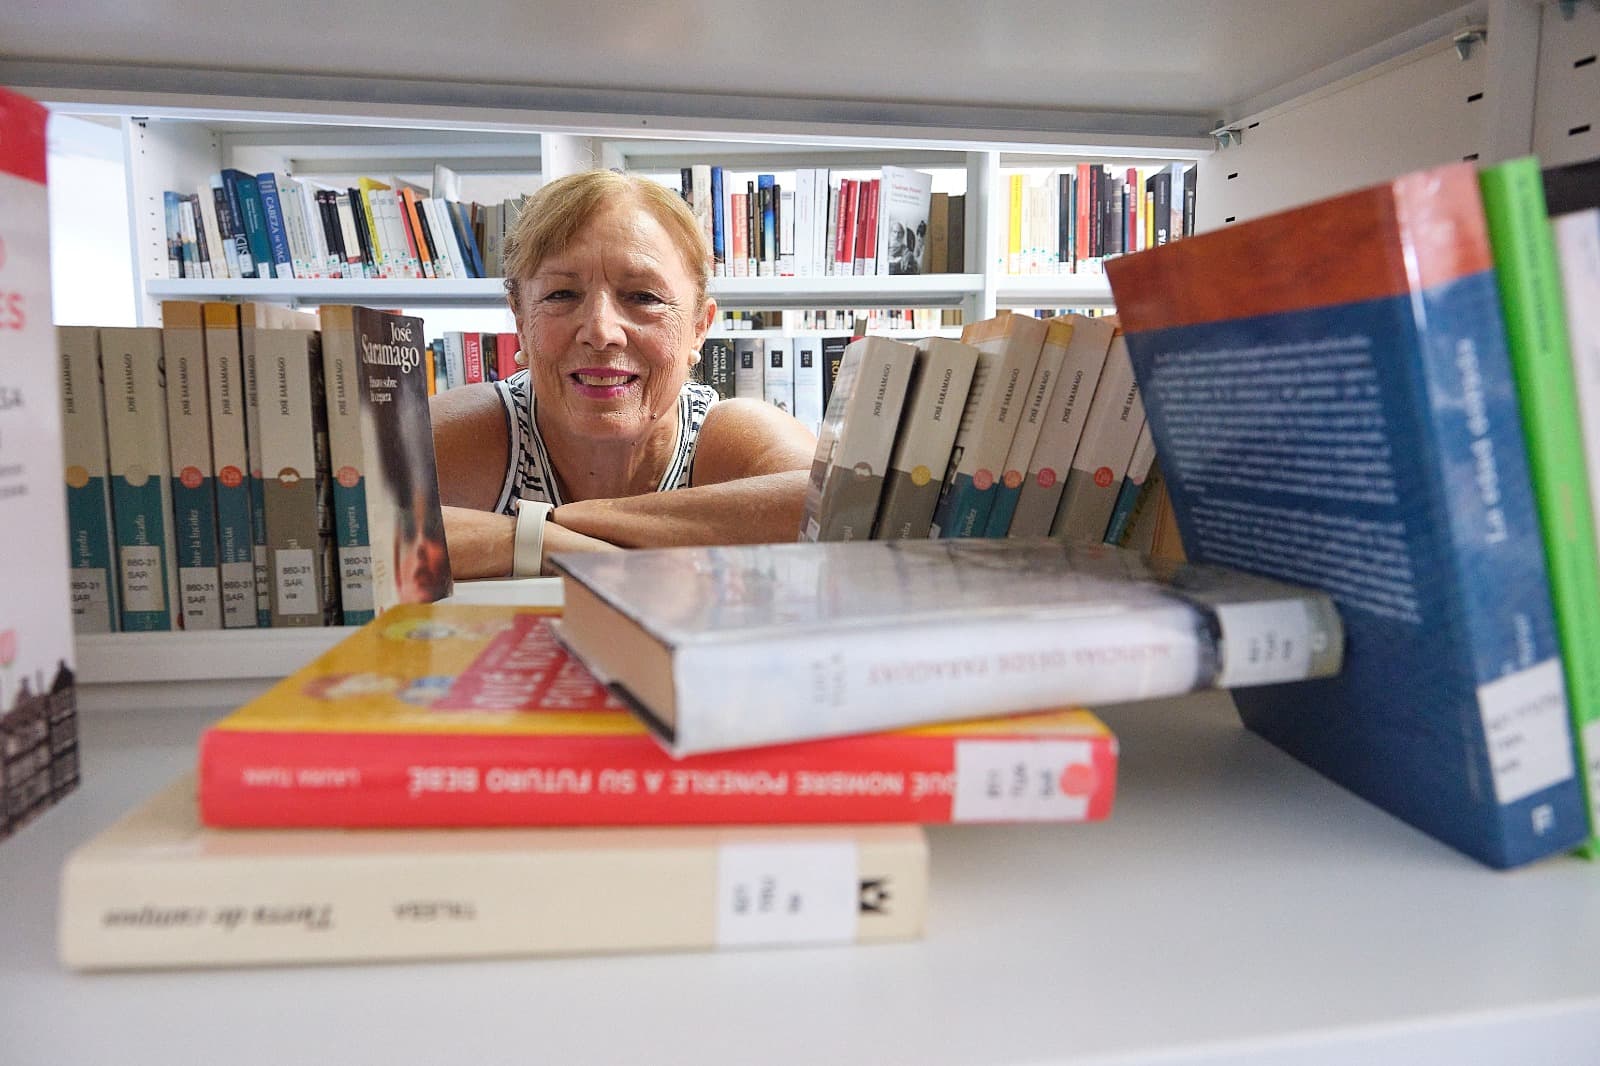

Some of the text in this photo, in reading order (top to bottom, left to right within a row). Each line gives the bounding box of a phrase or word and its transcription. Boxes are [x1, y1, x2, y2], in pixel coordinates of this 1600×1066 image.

[266, 196, 280, 234] CABEZA
[390, 322, 412, 344] José
[361, 334, 420, 374] Saramago
[469, 341, 480, 379] ARTURO
[123, 353, 137, 414] JOSÉ SARAMAGO
[179, 357, 192, 416] JOSÉ SARAMAGO
[220, 356, 232, 416] JOSÉ SARAMAGO
[278, 356, 290, 416] JOSÉ SARAMAGO
[336, 358, 348, 416] JOSÉ SARAMAGO
[720, 369, 726, 384] DE
[872, 364, 890, 416] JOSÉ SARAMAGO
[934, 368, 952, 421] JOSÉ SARAMAGO
[998, 368, 1019, 422] JOSÉ SARAMAGO
[1028, 370, 1051, 424] JOSÉ SARAMAGO
[1062, 370, 1083, 424] JOSÉ SARAMAGO
[1120, 381, 1138, 421] JOSÉ SARAM
[136, 514, 147, 546] plicado
[126, 558, 158, 568] 860-31
[128, 570, 149, 580] SAR
[282, 566, 310, 575] 860-31
[345, 568, 366, 578] SAR
[186, 582, 216, 592] 860-31
[224, 580, 253, 590] 860-31
[224, 592, 244, 602] SAR
[283, 580, 303, 588] SAR
[187, 594, 207, 604] SAR
[407, 766, 479, 797] BEBÉ
[485, 768, 592, 795] FUTURO
[598, 768, 637, 793] SU
[643, 772, 664, 792] A
[670, 770, 788, 796] PONERLE
[796, 771, 905, 798] NOMBRE
[212, 906, 247, 932] de
